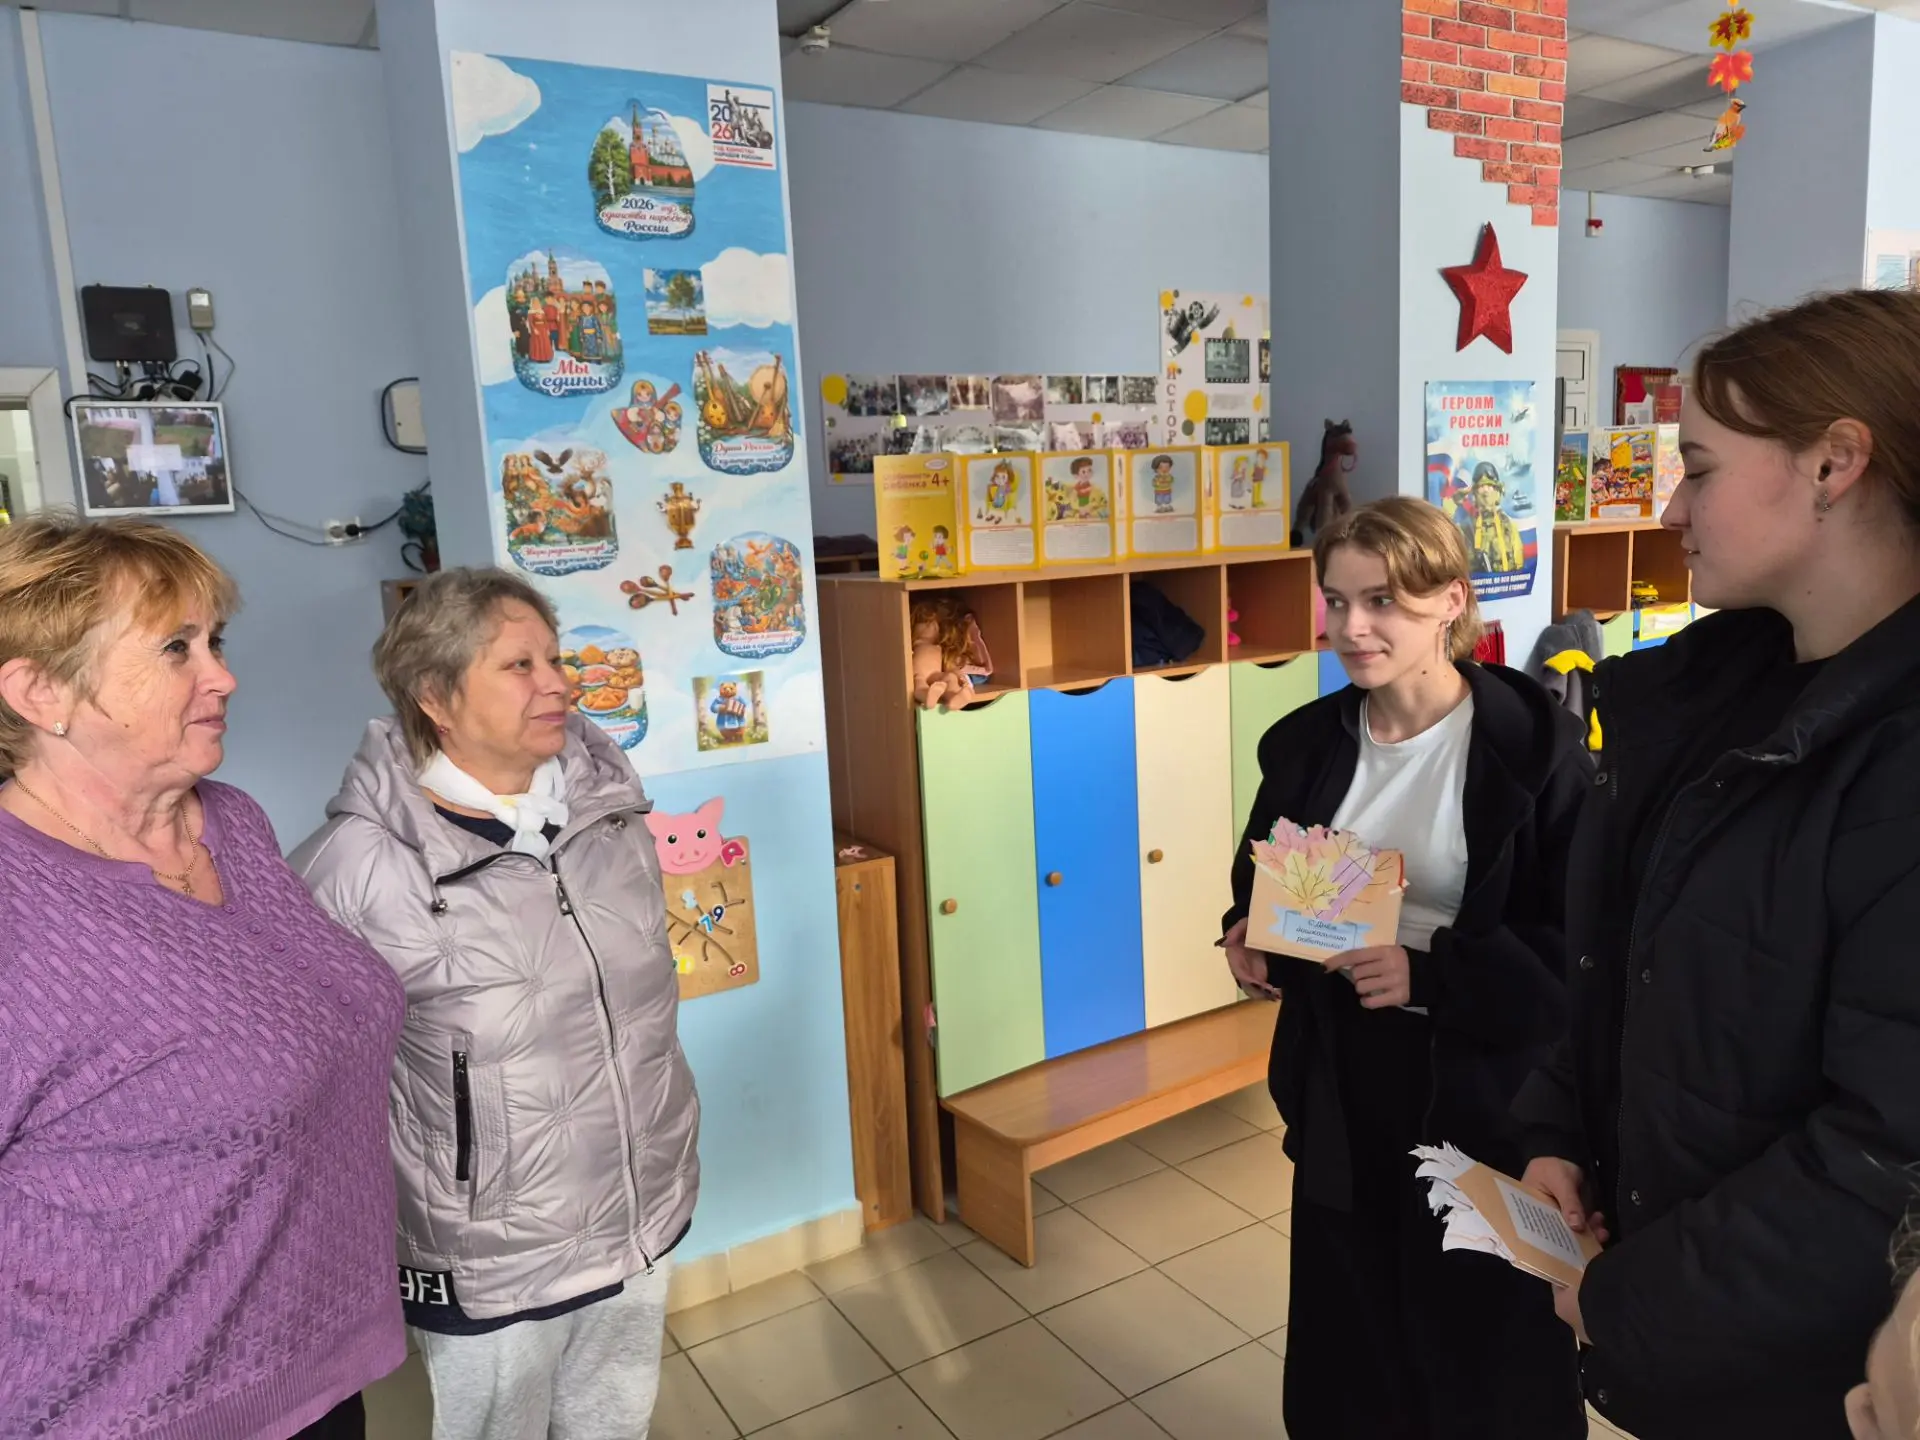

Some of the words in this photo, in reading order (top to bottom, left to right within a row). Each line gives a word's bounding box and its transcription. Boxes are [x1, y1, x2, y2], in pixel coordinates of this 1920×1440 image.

[711, 104, 731, 122] 20
[712, 122, 733, 139] 26
[621, 198, 653, 210] 2026
[623, 220, 669, 233] России
[552, 359, 589, 375] Мы
[542, 376, 604, 393] едины
[1441, 395, 1495, 411] ГЕРОЯМ
[1449, 414, 1503, 430] РОССИИ
[1461, 432, 1510, 448] СЛАВА!
[931, 473, 950, 487] 4+
